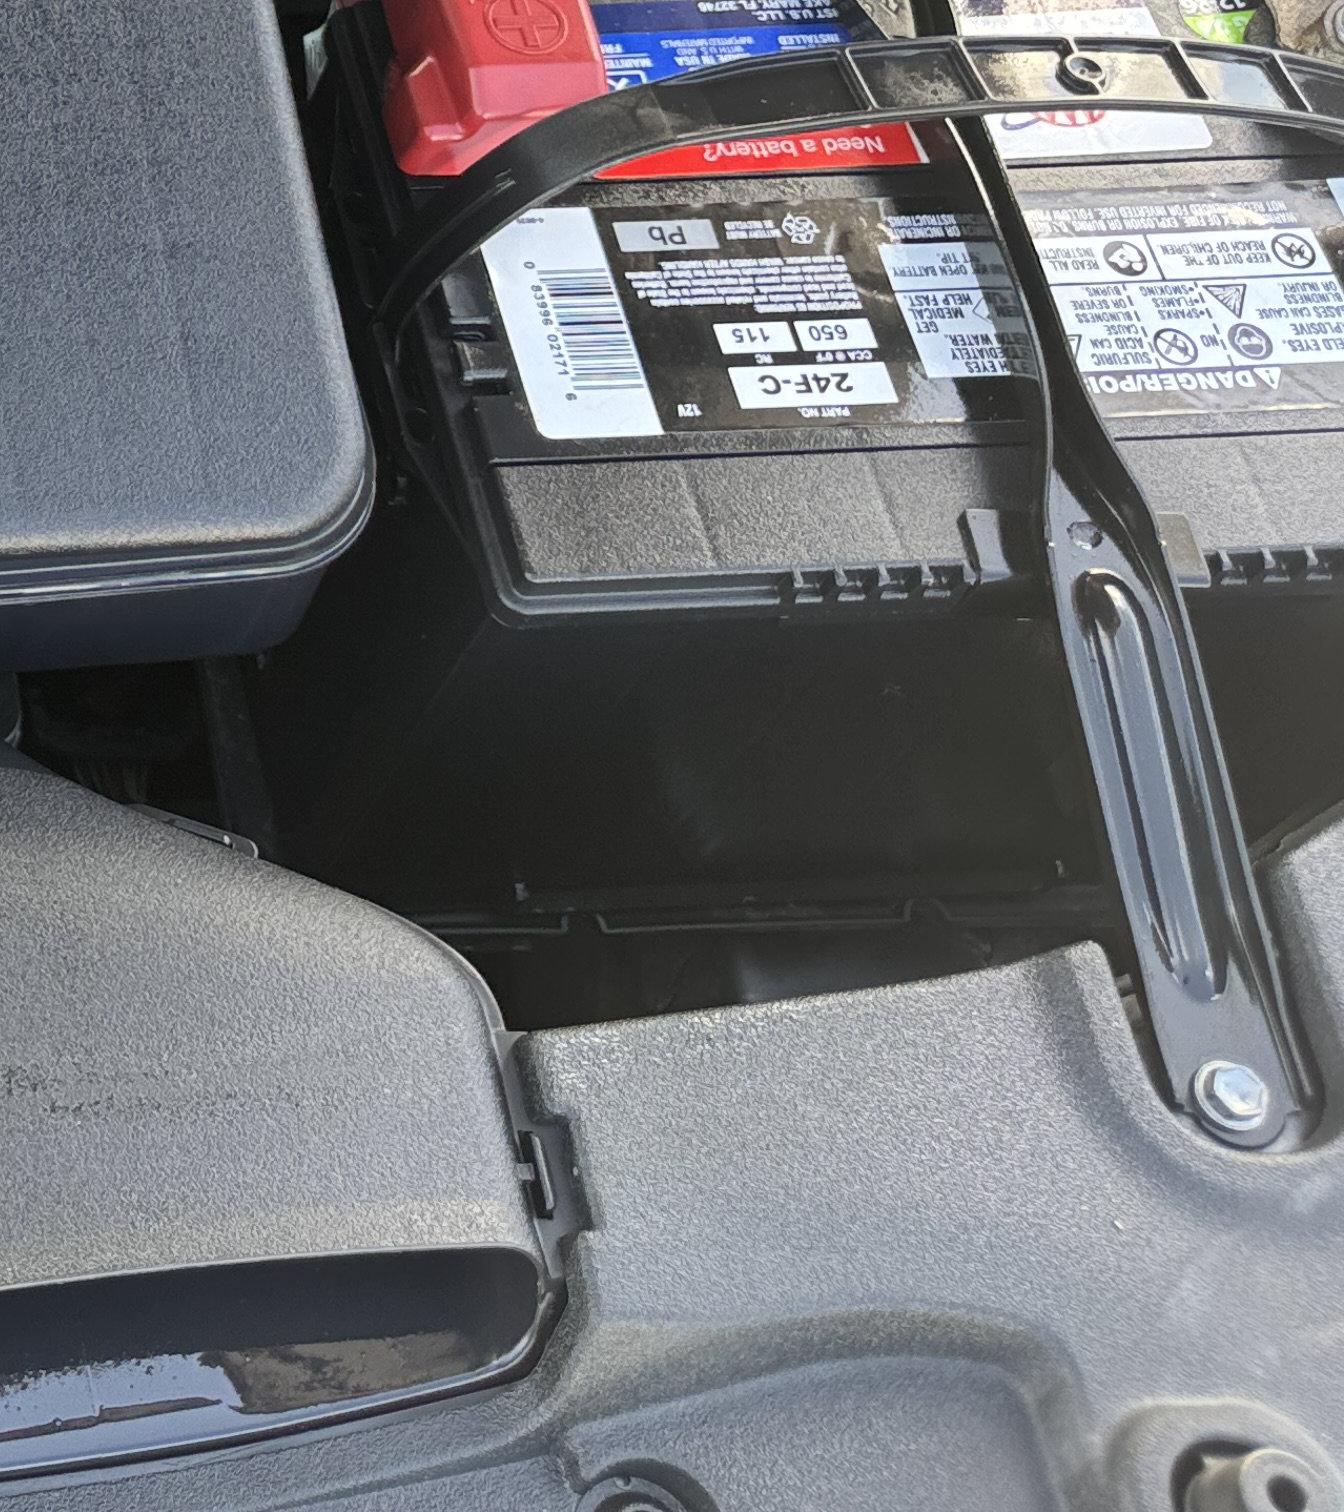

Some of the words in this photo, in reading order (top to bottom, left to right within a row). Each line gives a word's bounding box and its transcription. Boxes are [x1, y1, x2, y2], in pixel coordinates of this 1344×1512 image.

[674, 55, 699, 69] USA
[702, 138, 795, 163] battery?
[804, 138, 817, 154] a
[825, 135, 885, 155] Need
[648, 226, 688, 246] Pb
[1214, 241, 1228, 253] OF
[1232, 241, 1266, 253] REACH
[1205, 255, 1219, 265] OF
[1223, 254, 1244, 265] OUT
[1246, 253, 1271, 264] KEEP
[939, 264, 967, 277] OPEN
[1050, 261, 1069, 271] ALL
[1070, 260, 1099, 271] READ
[1321, 281, 1336, 293] OR
[903, 295, 937, 307] FAST.
[942, 293, 972, 306] HELP
[1110, 298, 1126, 309] OR
[1283, 292, 1342, 304] BLINDNESS
[1070, 299, 1109, 310] SEVERE
[907, 307, 964, 320] MEDICAL
[1075, 311, 1132, 323] BLINDNESS
[1256, 308, 1288, 319] CAUSE
[1290, 307, 1310, 318] CAN
[529, 284, 553, 327] 83996
[546, 333, 570, 377] 02171
[808, 324, 848, 342] 650
[915, 321, 938, 333] GET
[1103, 324, 1139, 335] CAUSE
[731, 326, 770, 342] 115
[944, 333, 991, 346] WATER.
[1200, 334, 1218, 346] NO
[1089, 338, 1112, 350] CAN
[1114, 337, 1144, 349] ACID
[1282, 338, 1317, 351] EYES.
[753, 352, 772, 363] RC
[846, 349, 873, 362] CCA
[1090, 351, 1152, 365] SULFURIC
[965, 360, 995, 373] EYES
[757, 371, 853, 395] 24F-C
[677, 403, 702, 416] 12V
[798, 406, 821, 417] NO.
[822, 406, 851, 416] PART
